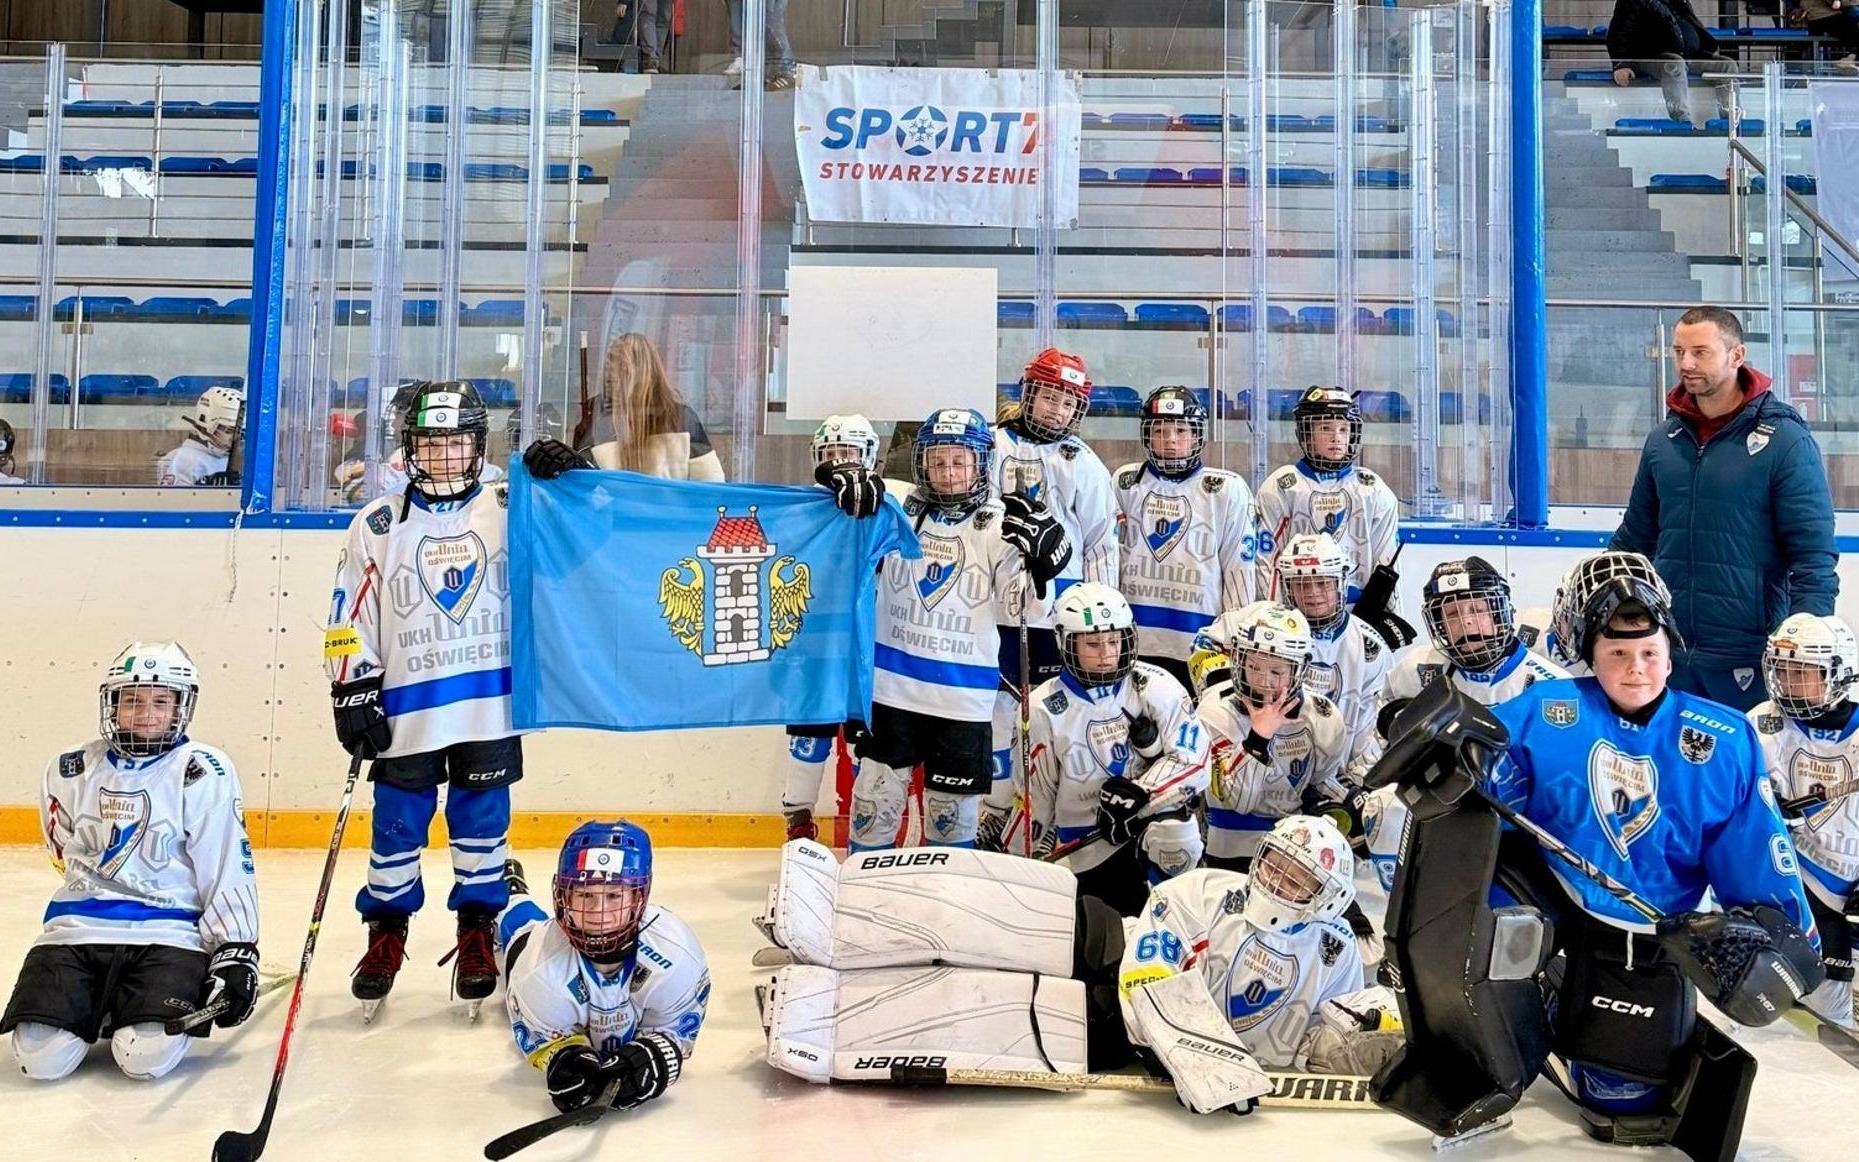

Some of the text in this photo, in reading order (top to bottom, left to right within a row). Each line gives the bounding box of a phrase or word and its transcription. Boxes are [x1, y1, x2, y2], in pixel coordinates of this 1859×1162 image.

[819, 162, 1038, 185] STOWARZYSZENIE
[1175, 721, 1199, 753] 11
[468, 767, 507, 782] CCM
[932, 774, 974, 787] CCM
[860, 852, 950, 870] BAUER
[1135, 930, 1182, 965] 68
[1591, 995, 1656, 1019] CCM
[1176, 1037, 1245, 1062] BAUER
